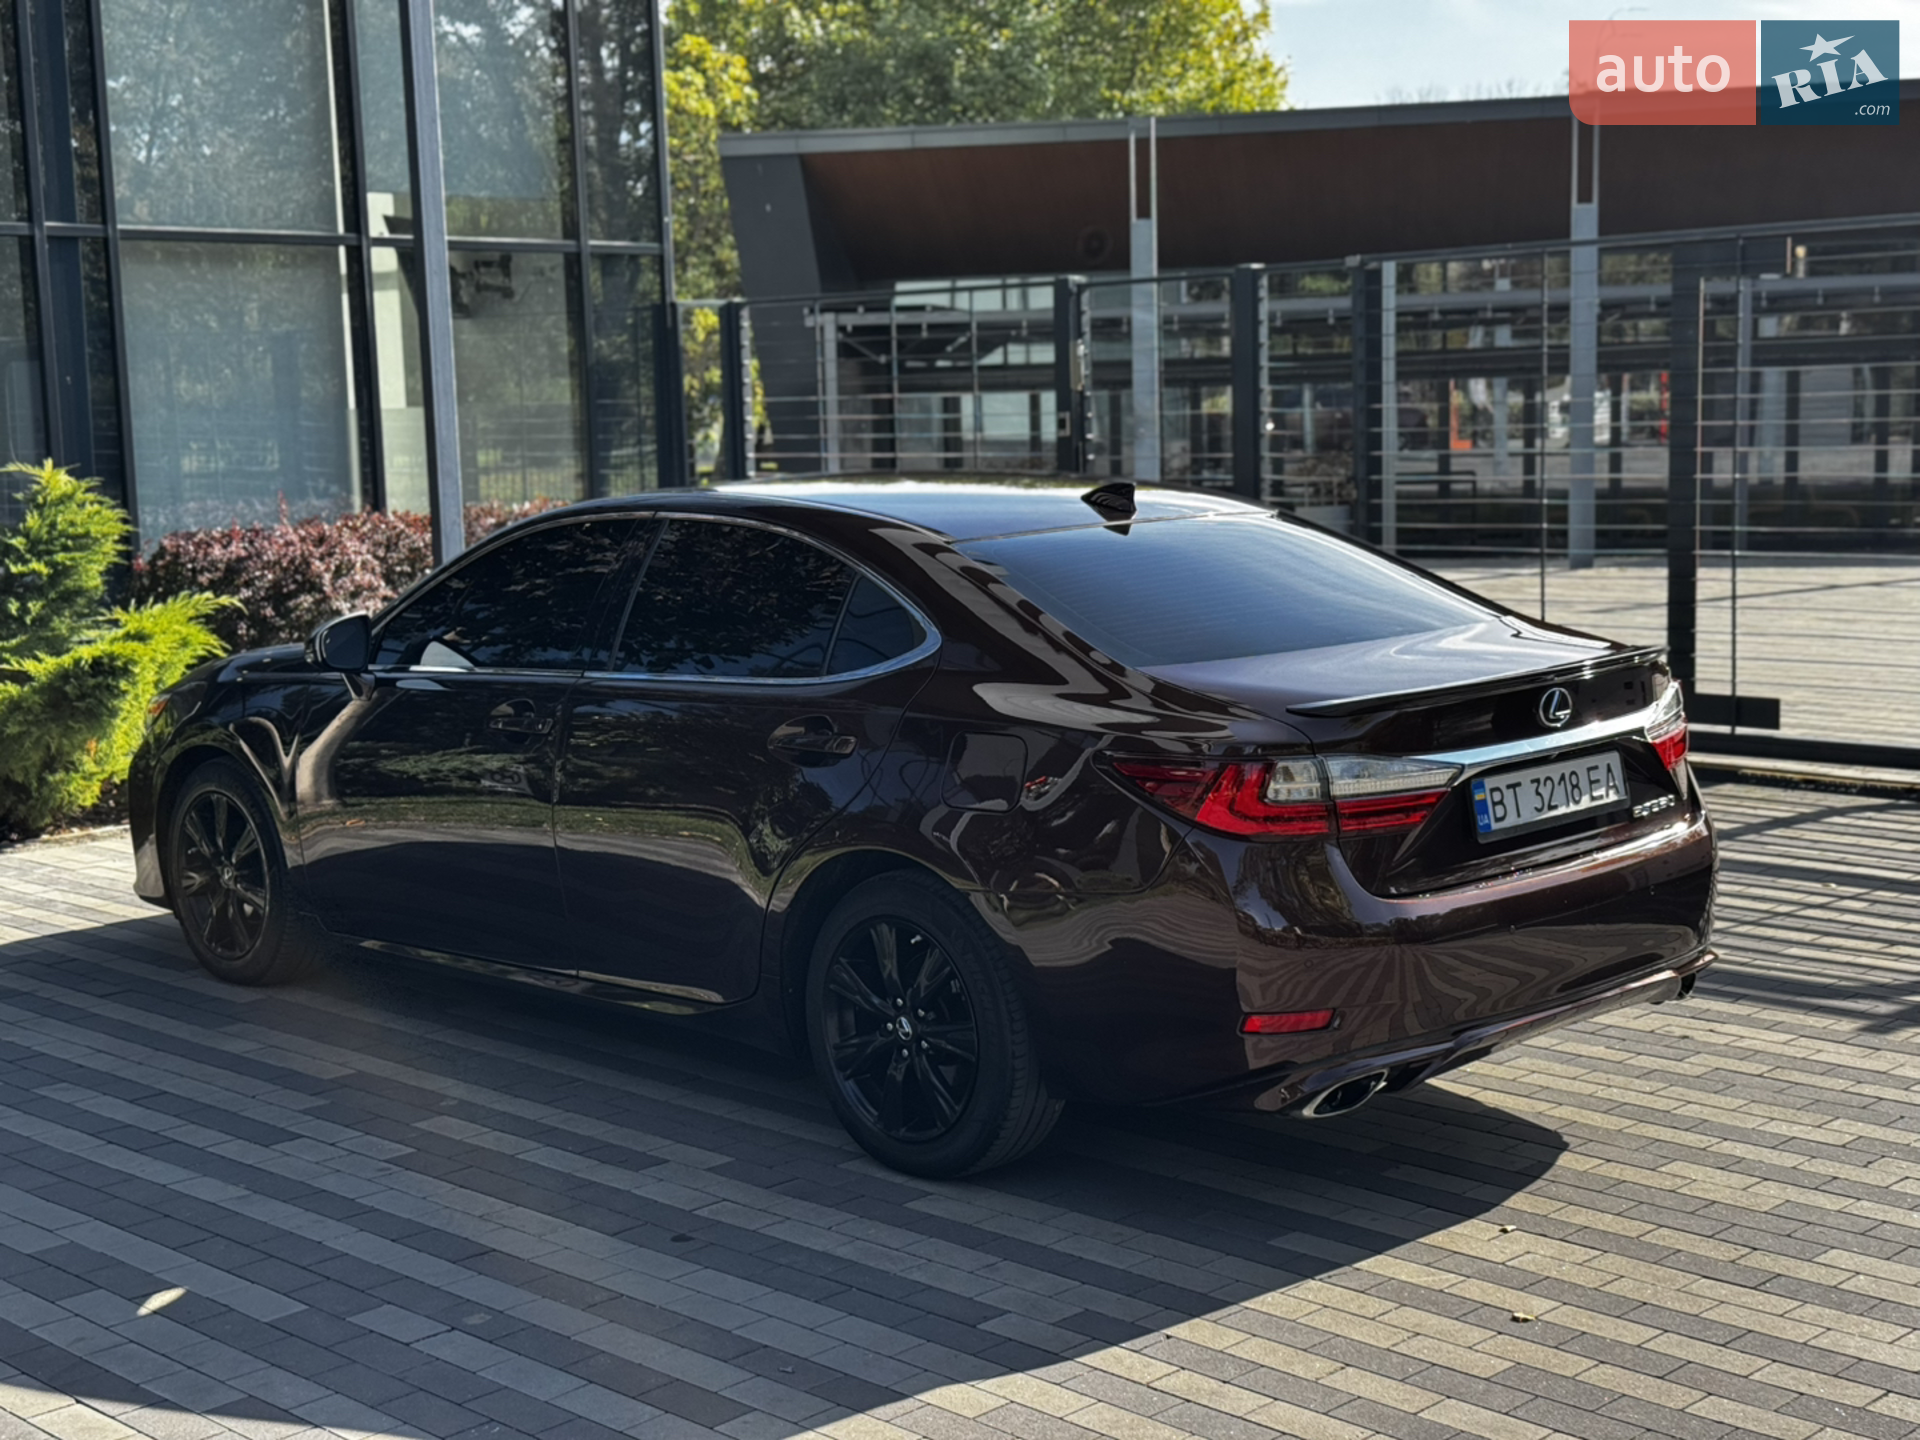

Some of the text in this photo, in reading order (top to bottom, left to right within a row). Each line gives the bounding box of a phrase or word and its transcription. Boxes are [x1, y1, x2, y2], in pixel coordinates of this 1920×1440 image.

[1489, 762, 1620, 823] BT 3218 EA
[1477, 813, 1490, 826] UA
